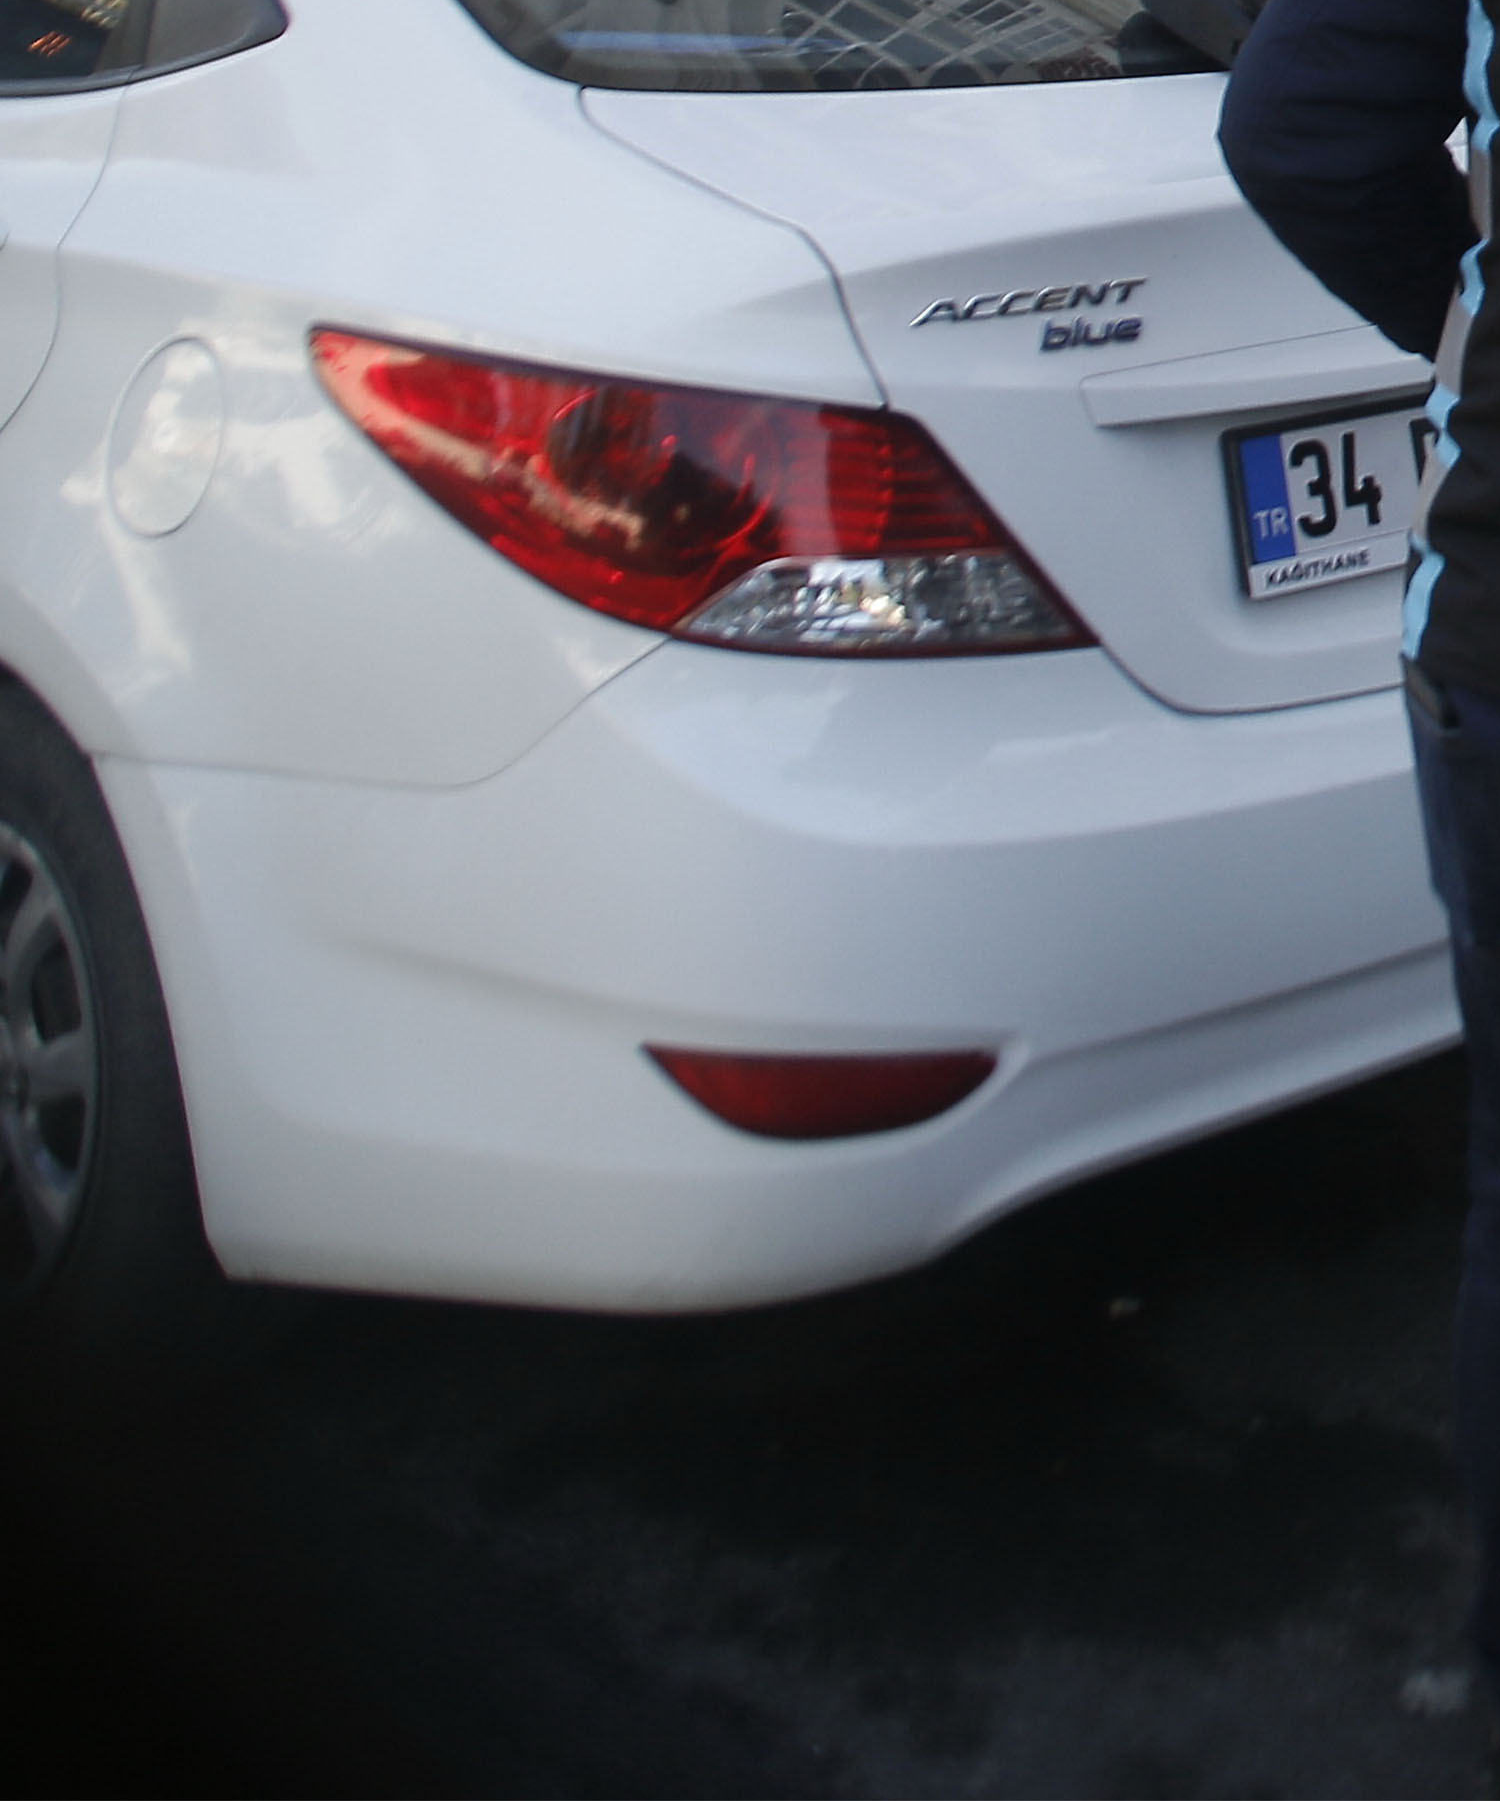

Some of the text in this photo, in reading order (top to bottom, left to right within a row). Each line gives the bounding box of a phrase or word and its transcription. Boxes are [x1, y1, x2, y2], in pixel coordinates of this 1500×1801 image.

[908, 276, 1150, 328] ACCENT
[1039, 313, 1144, 353] blue
[1289, 430, 1383, 538] 34
[1253, 506, 1291, 541] TR
